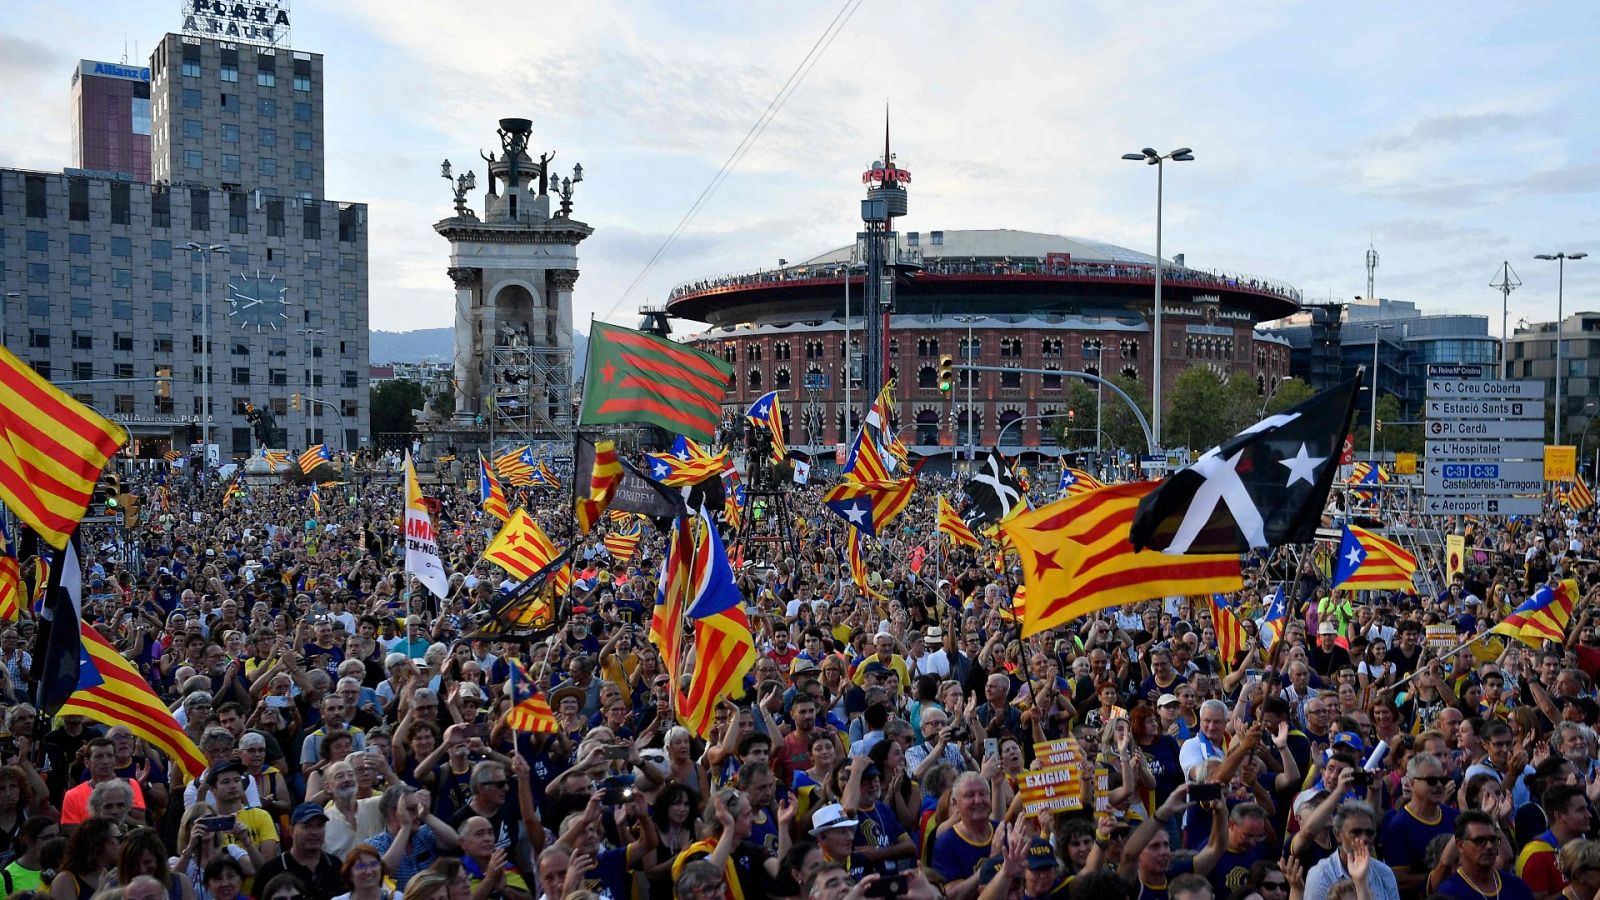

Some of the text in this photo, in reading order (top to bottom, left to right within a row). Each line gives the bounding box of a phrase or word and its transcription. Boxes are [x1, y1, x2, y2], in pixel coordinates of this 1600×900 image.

[94, 63, 139, 78] Allianz
[1444, 382, 1521, 394] C. Creu Coberta
[1443, 402, 1509, 414] Estació Sants
[181, 415, 214, 423] PLAA
[1443, 423, 1487, 434] Pl. Cerdà
[1443, 443, 1501, 455] L'Hospitalet
[1446, 466, 1495, 477] C-31 C-32
[1442, 479, 1541, 491] Castelldefels-Tarragona
[616, 489, 655, 503] ORIREM
[1442, 500, 1484, 513] Aeroport
[1049, 751, 1074, 764] VOTAR
[1025, 769, 1071, 788] EXIGIM
[1044, 786, 1056, 797] LA
